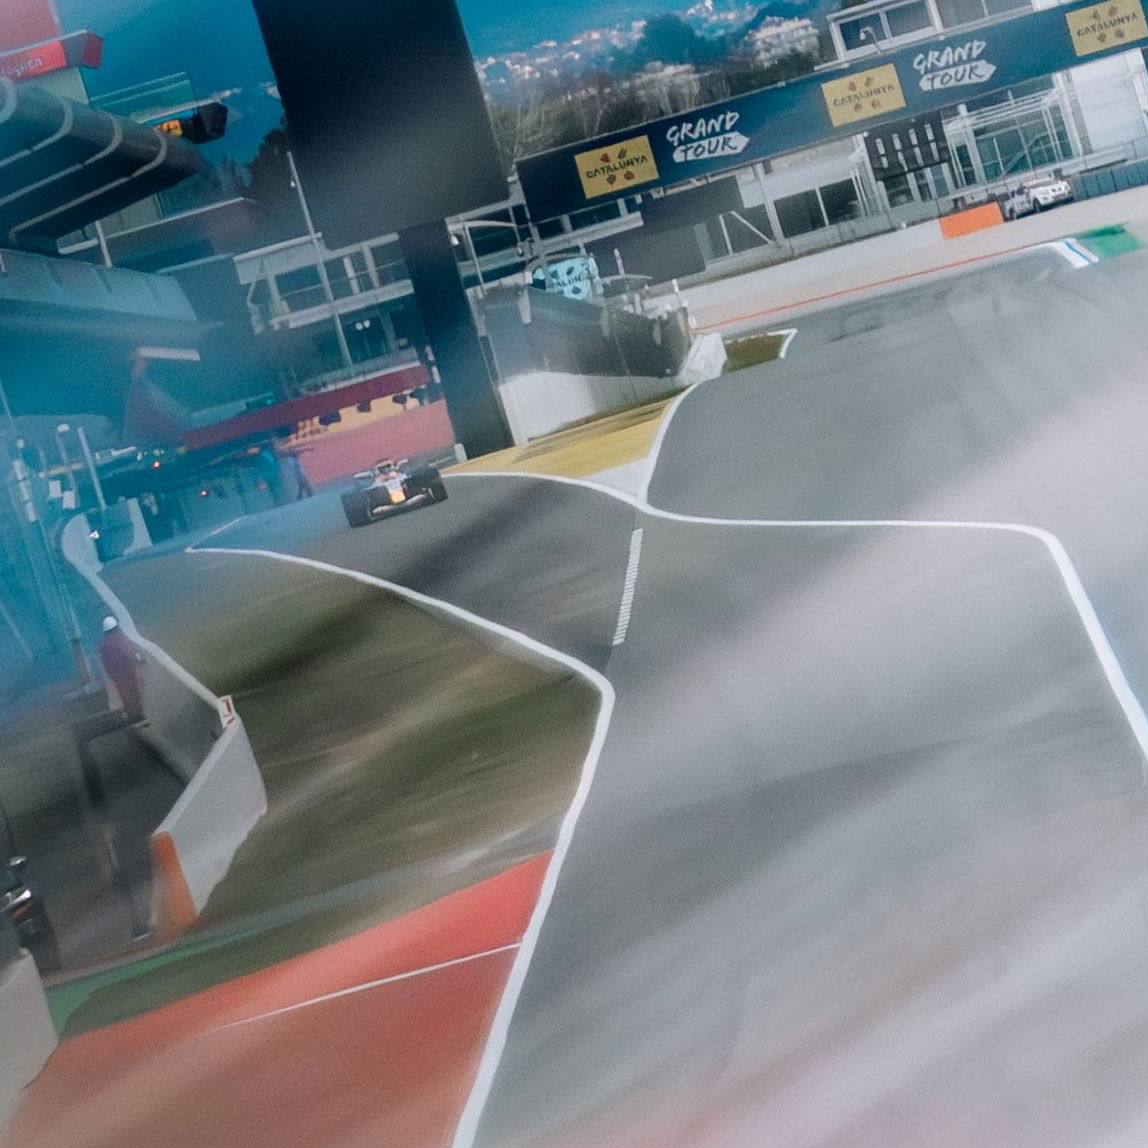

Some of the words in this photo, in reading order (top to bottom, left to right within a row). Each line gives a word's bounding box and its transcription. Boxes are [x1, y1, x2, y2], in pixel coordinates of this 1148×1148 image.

[1076, 12, 1139, 37] CATALUNYA
[912, 39, 987, 75] GRAND
[925, 63, 985, 90] TOUR
[665, 110, 740, 146] GRAND
[676, 135, 738, 162] TOUR
[586, 154, 649, 180] CATALUNYA
